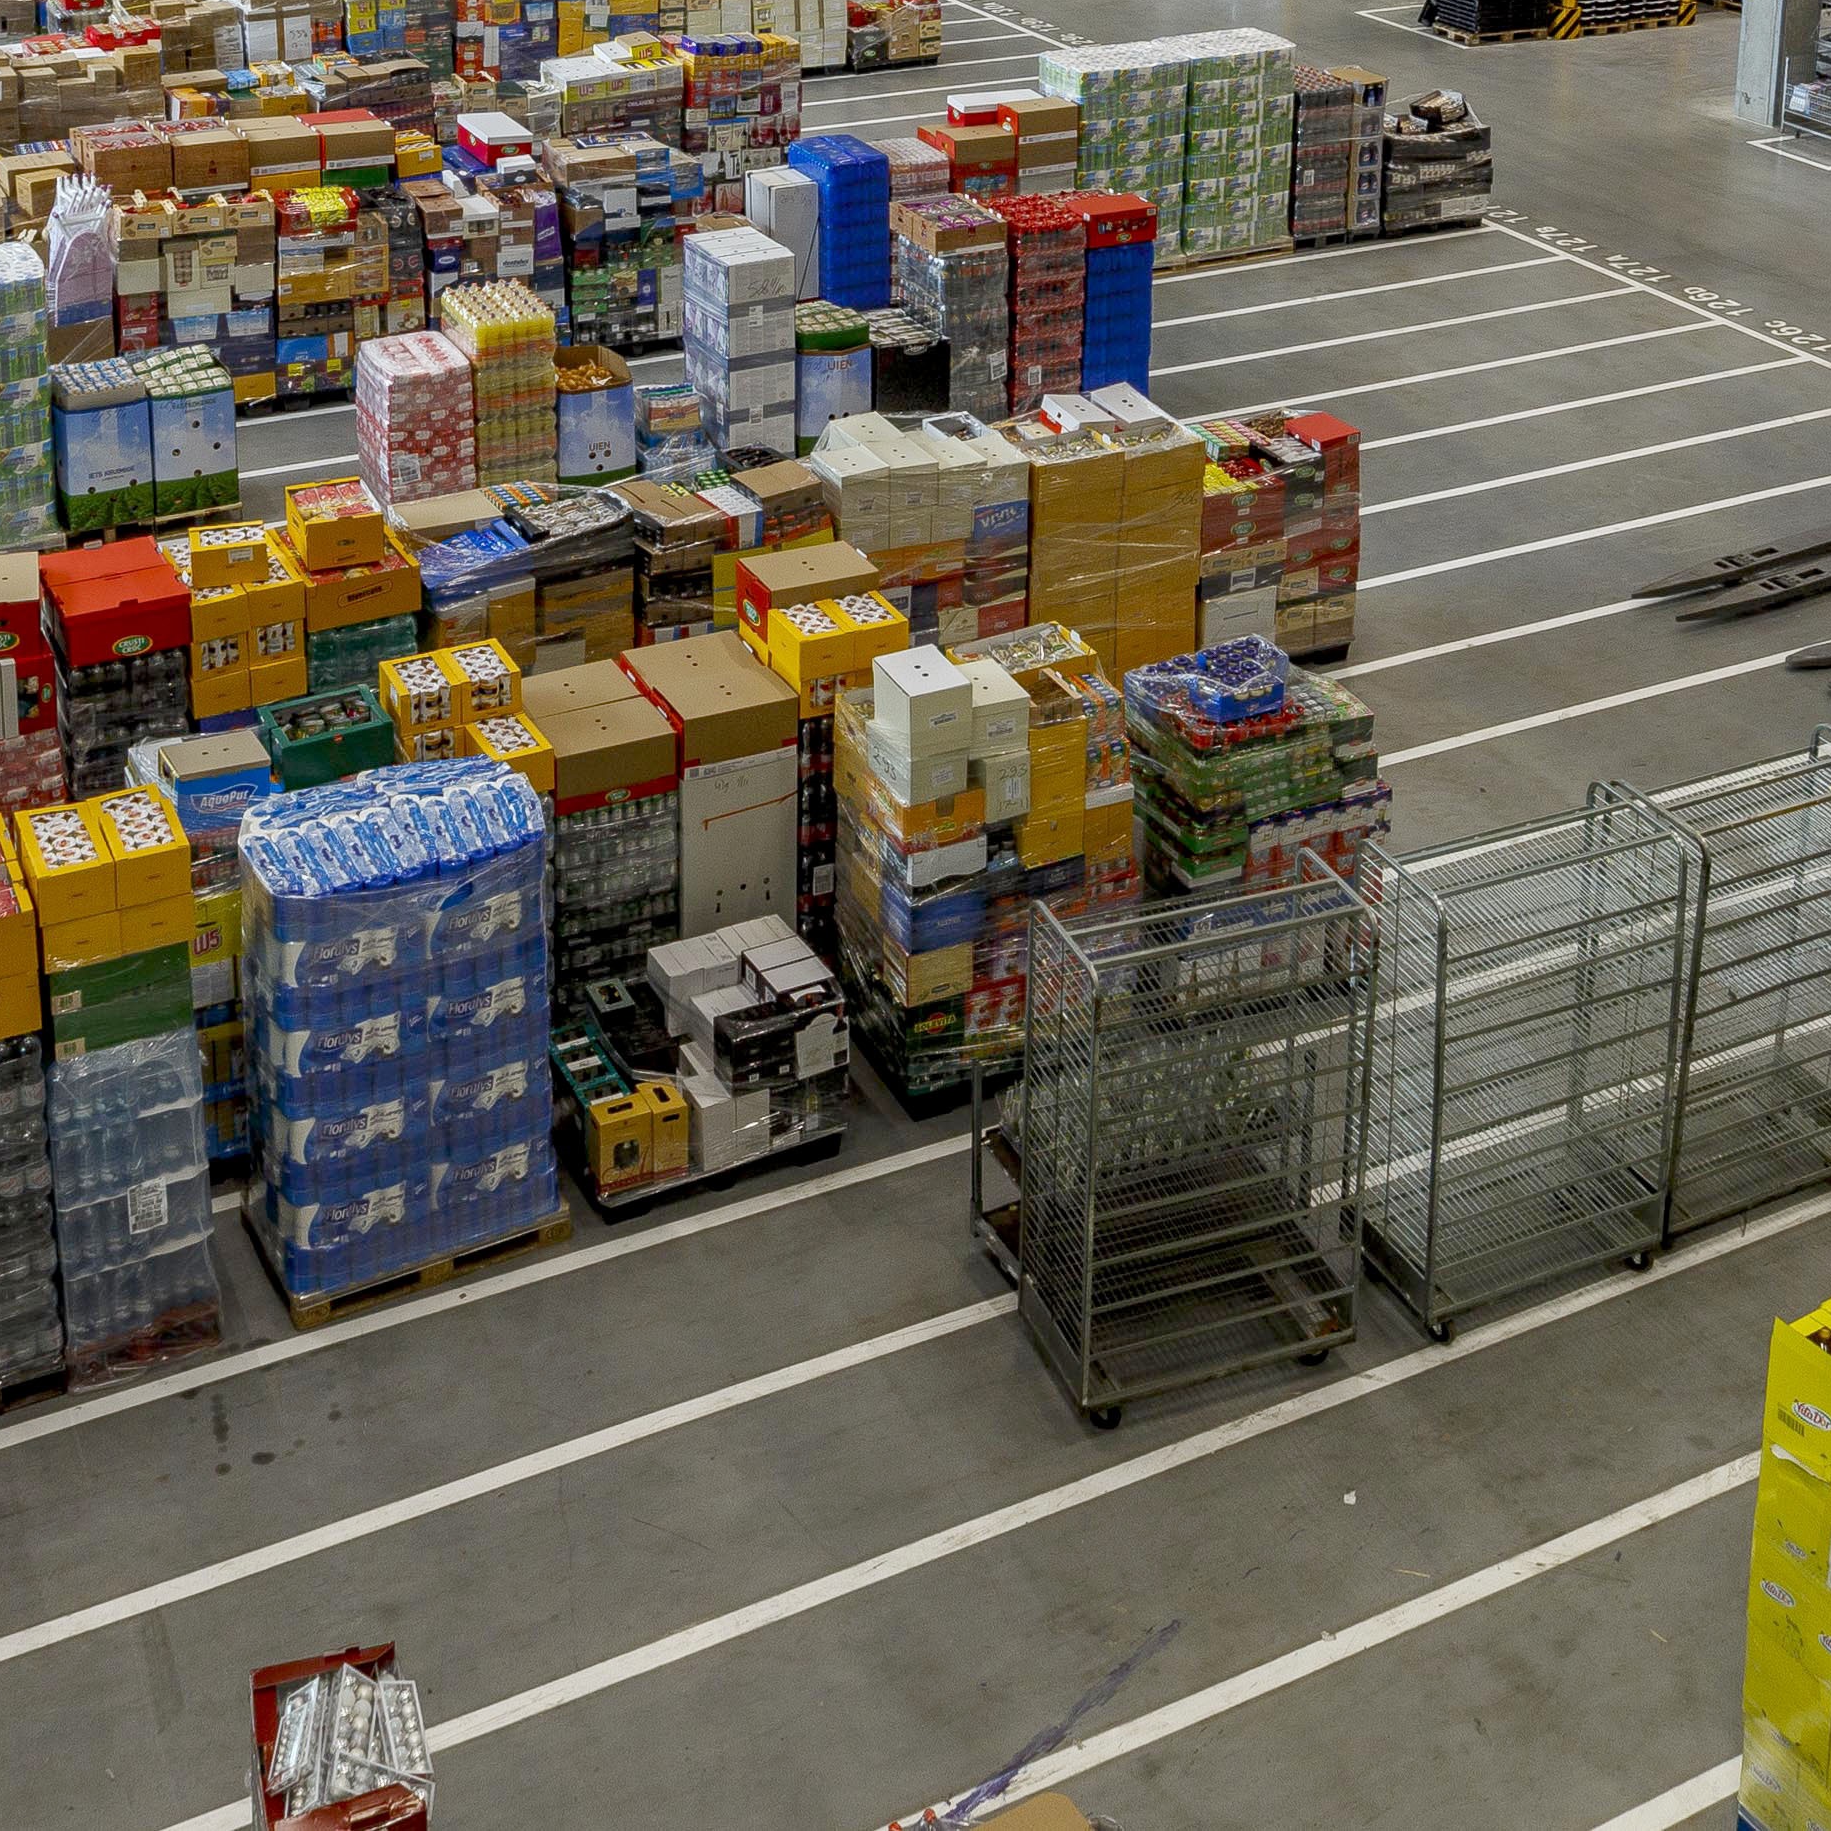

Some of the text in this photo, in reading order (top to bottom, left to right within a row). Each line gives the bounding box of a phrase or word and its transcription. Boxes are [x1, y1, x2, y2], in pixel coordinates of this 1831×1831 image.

[1535, 225, 1598, 252] 127B
[1606, 254, 1672, 282] 127A
[1683, 286, 1754, 316] 126D
[828, 360, 852, 370] UIEN
[588, 442, 610, 451] UIEN
[200, 791, 251, 809] AquaPur
[448, 994, 492, 1014] Floralys
[318, 1029, 362, 1050] Floralys
